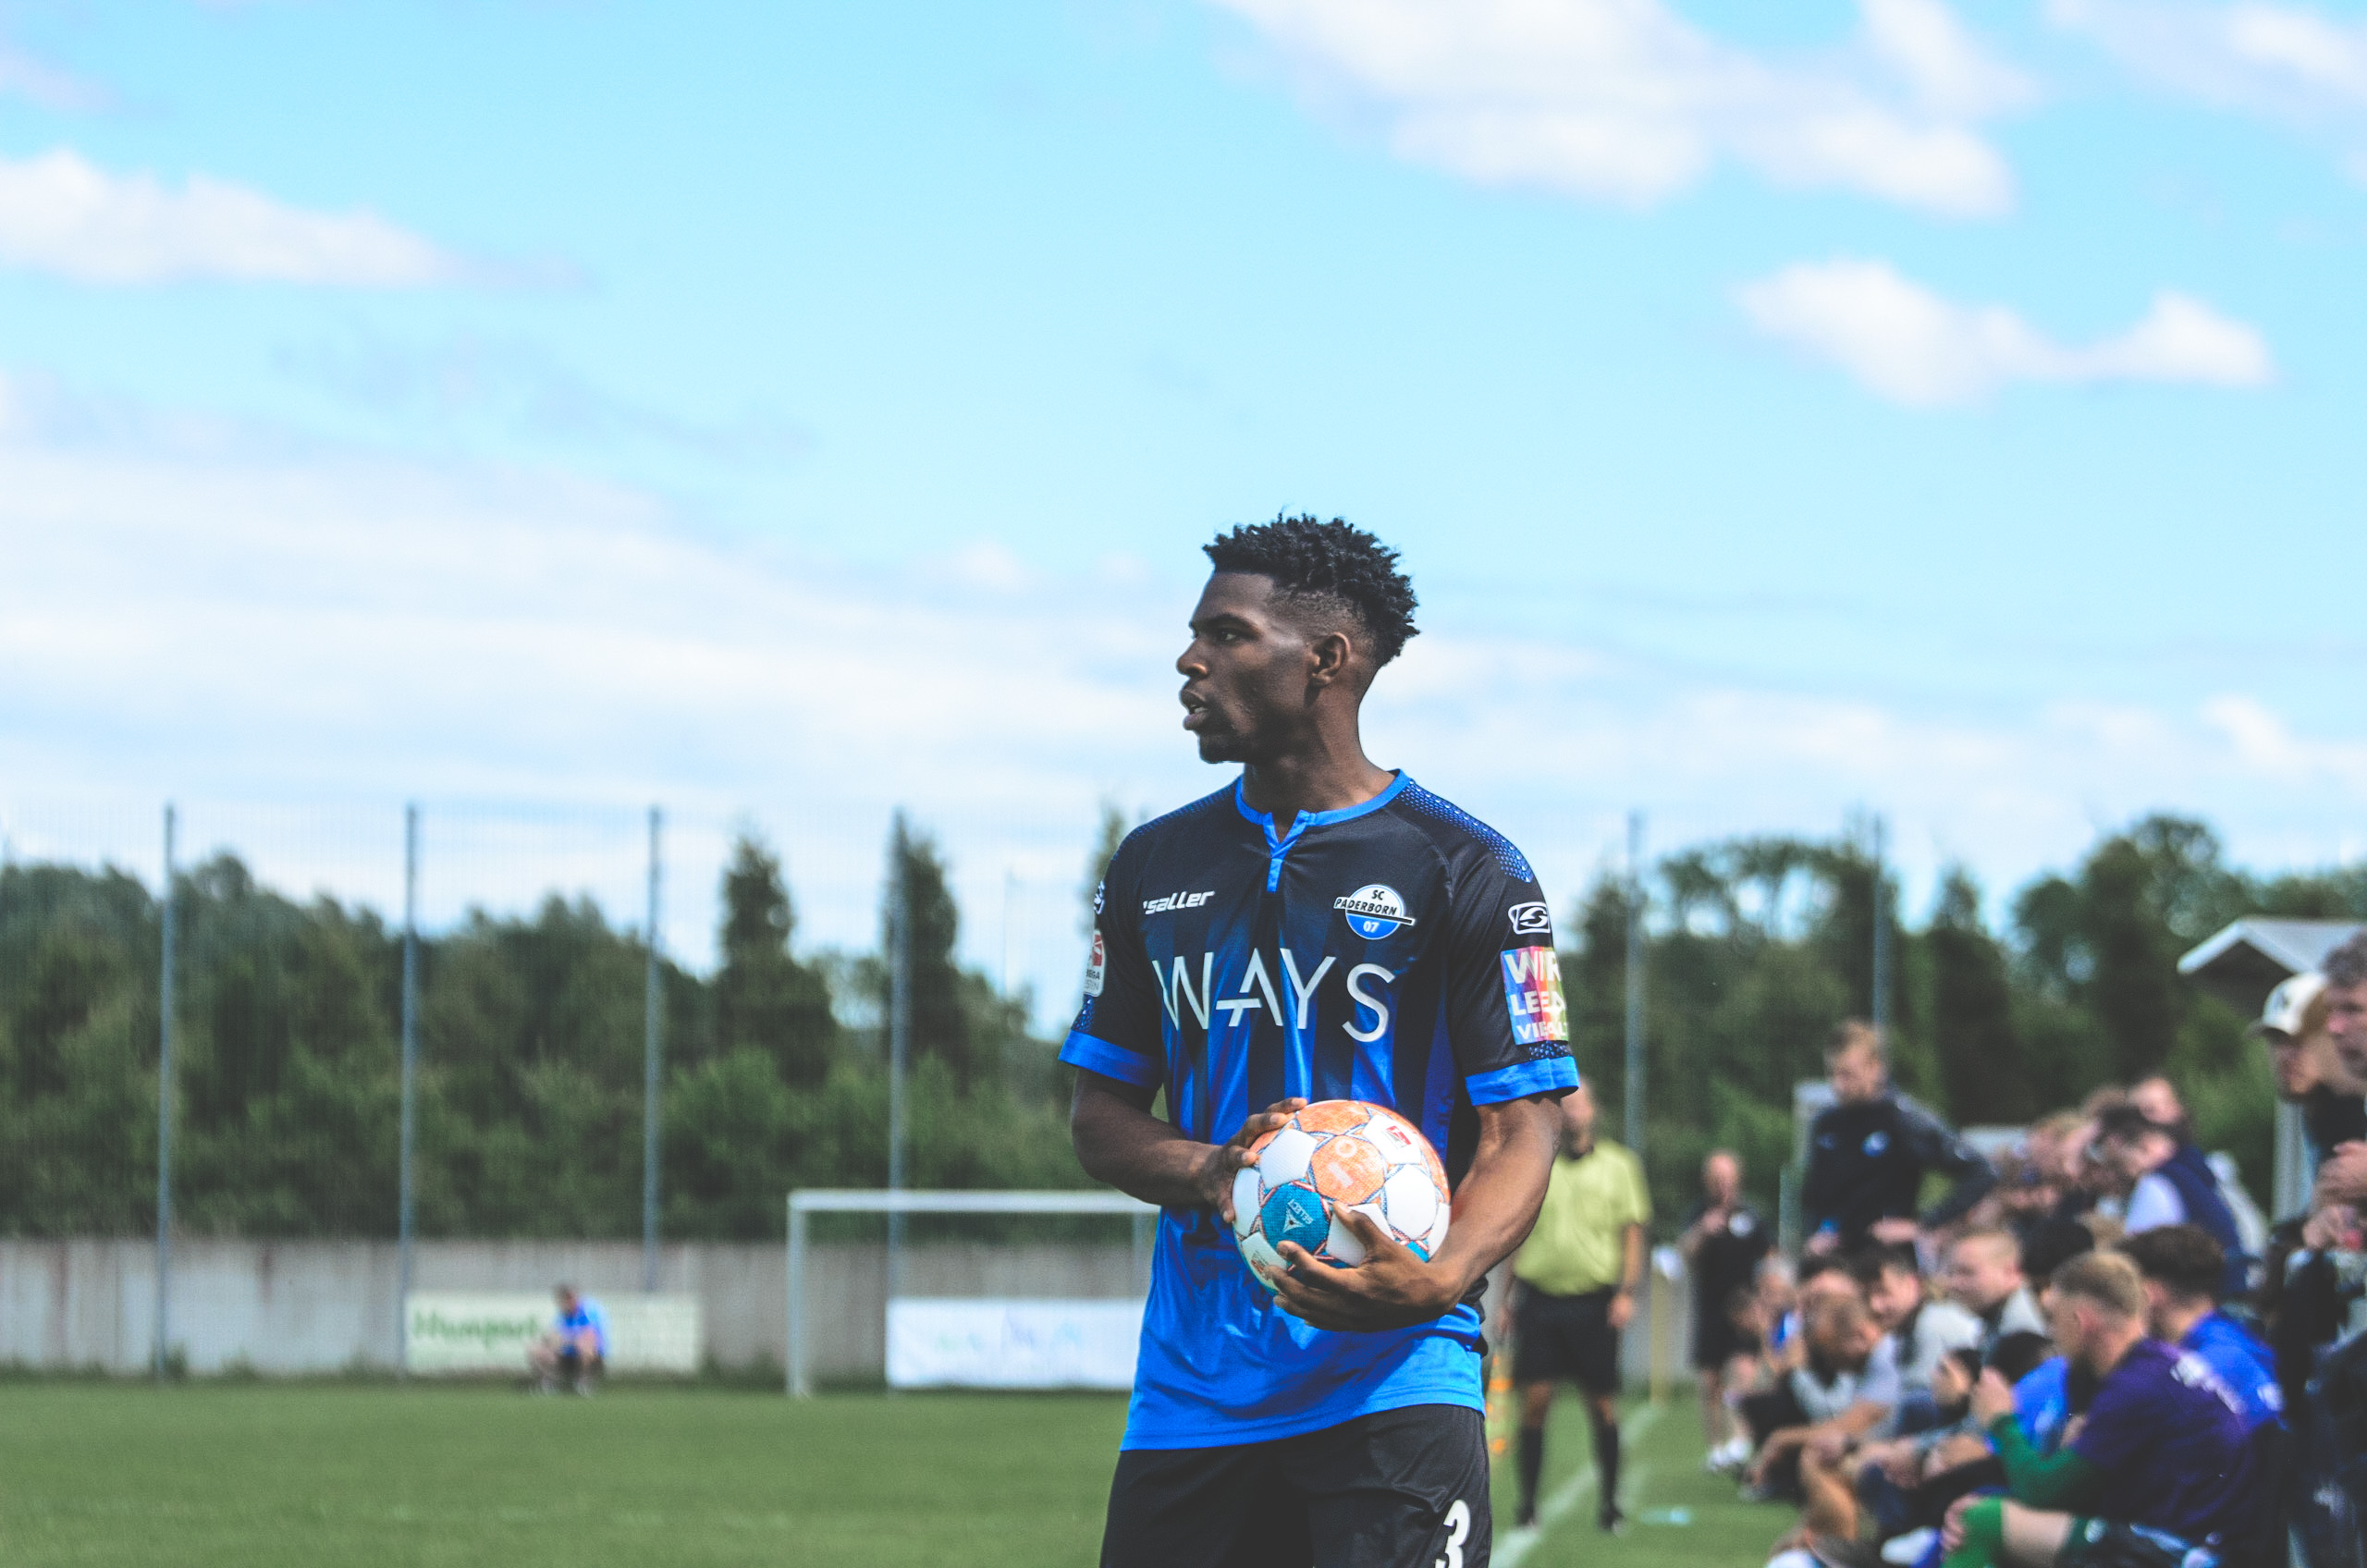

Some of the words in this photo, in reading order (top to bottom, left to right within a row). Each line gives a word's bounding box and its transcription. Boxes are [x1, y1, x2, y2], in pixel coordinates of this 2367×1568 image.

[1335, 898, 1397, 915] PADERBORN
[1371, 889, 1385, 900] SC
[1363, 920, 1380, 933] 07
[1503, 950, 1561, 985] WIR
[1152, 948, 1395, 1042] WAYS
[1287, 1199, 1314, 1224] SELECT
[1435, 1500, 1470, 1568] 3
